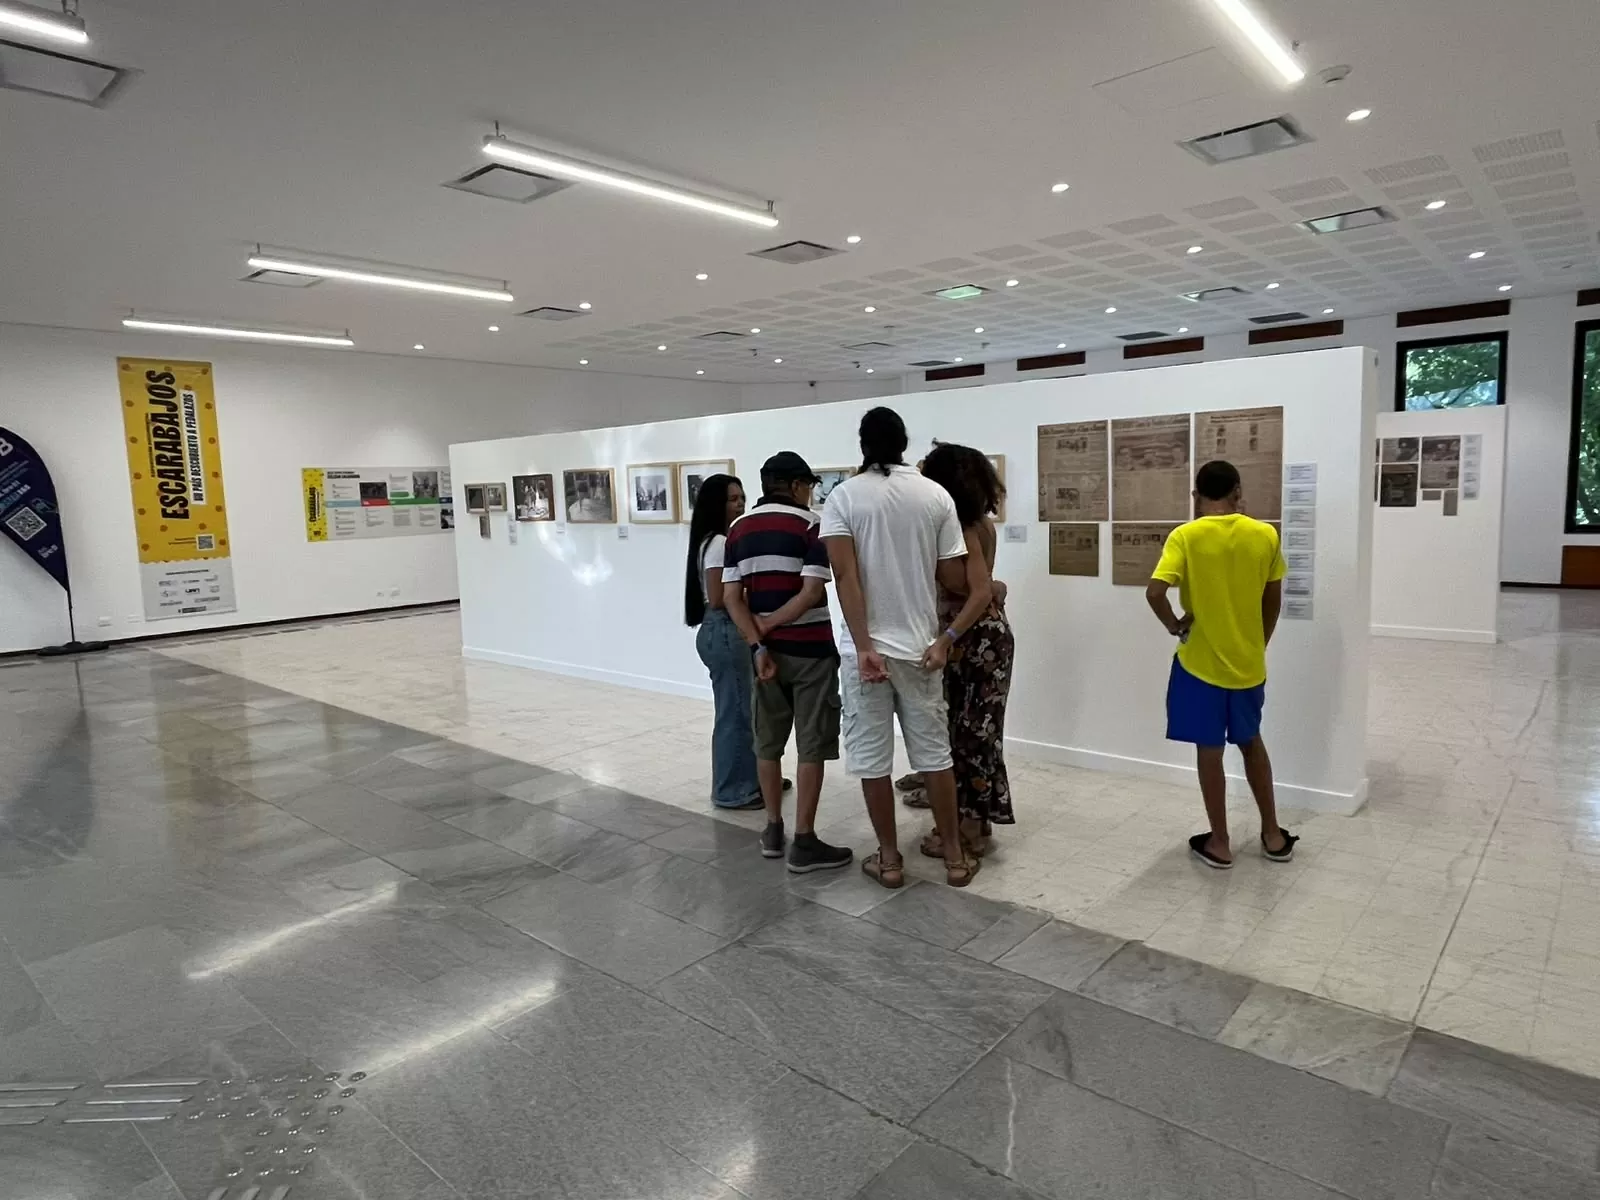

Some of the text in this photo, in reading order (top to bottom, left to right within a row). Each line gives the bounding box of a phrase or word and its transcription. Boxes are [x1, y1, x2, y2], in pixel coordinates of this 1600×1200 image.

[183, 393, 197, 429] PEDALAZOS
[146, 370, 189, 519] ESCARABAJOS
[187, 434, 201, 476] DESCUBIERTO
[191, 477, 202, 492] PAÍS
